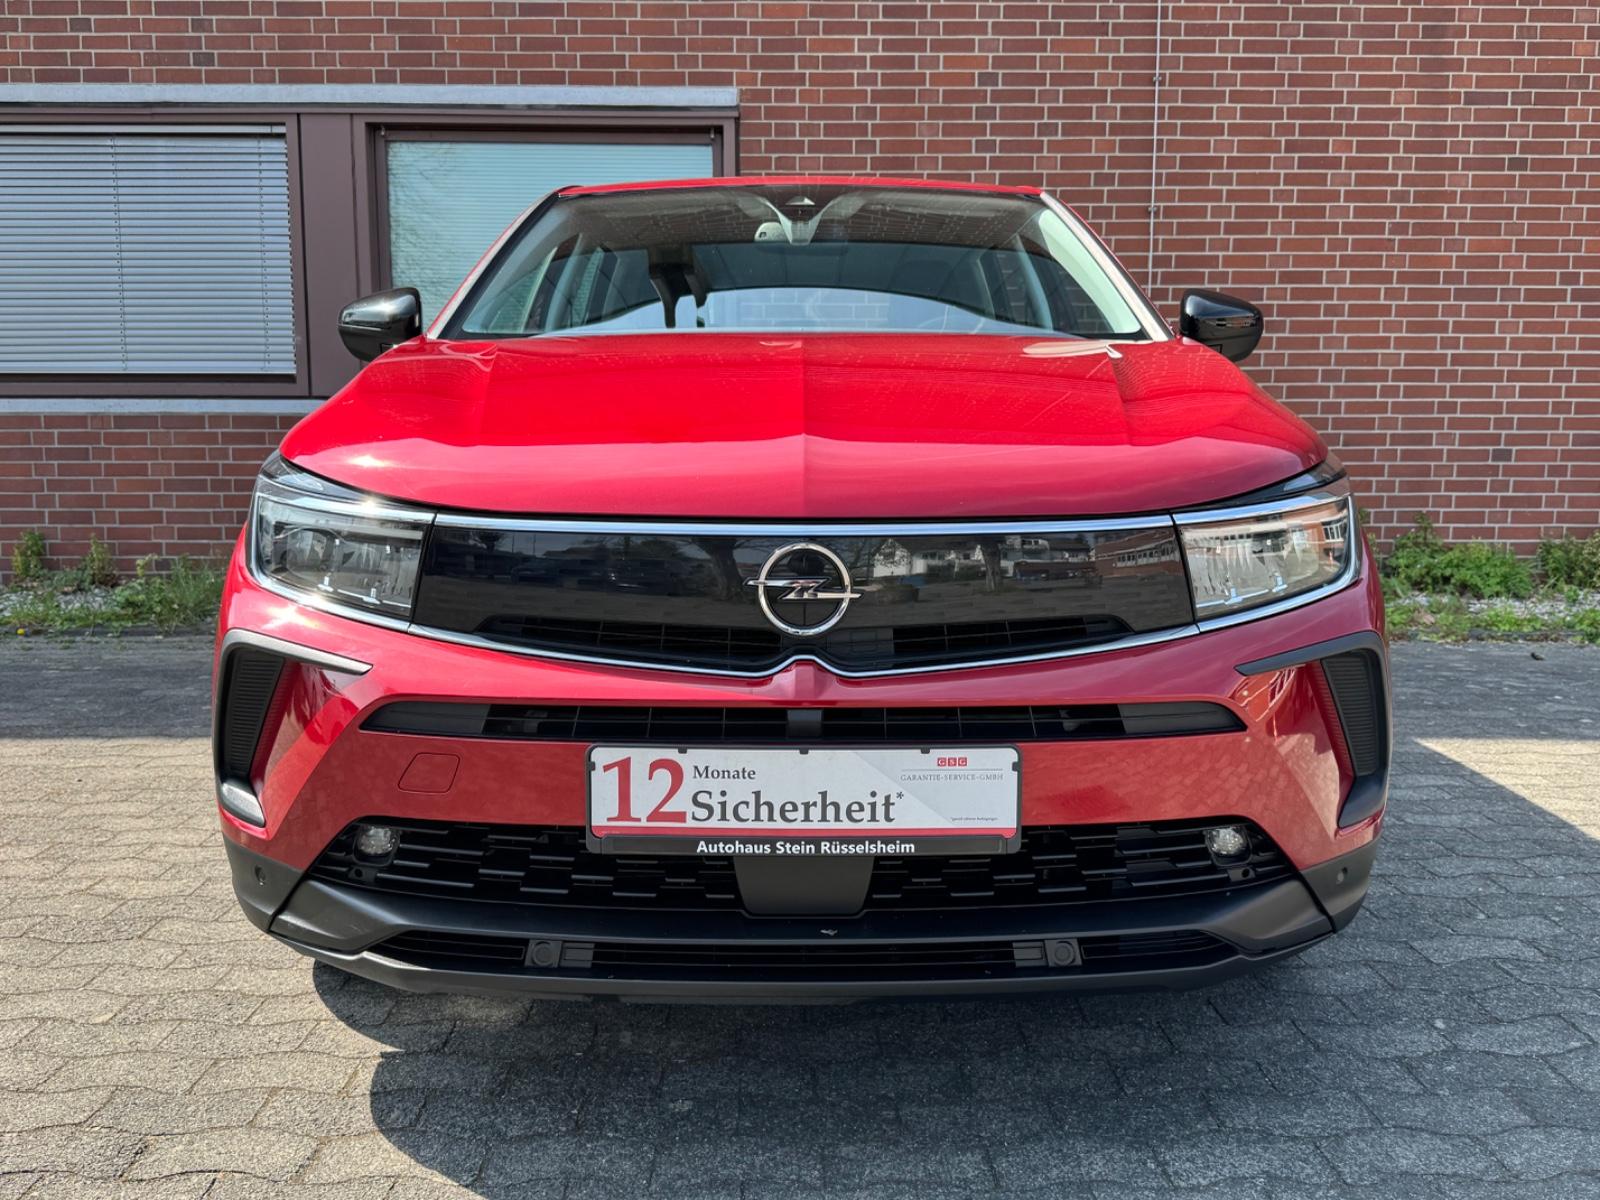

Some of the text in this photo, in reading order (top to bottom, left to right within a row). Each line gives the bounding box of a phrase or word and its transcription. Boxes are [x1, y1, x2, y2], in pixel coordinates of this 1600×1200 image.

[692, 765, 756, 780] Monate
[602, 756, 687, 823] 12
[696, 841, 915, 855] Autohaus Stein Rüsselsheim
